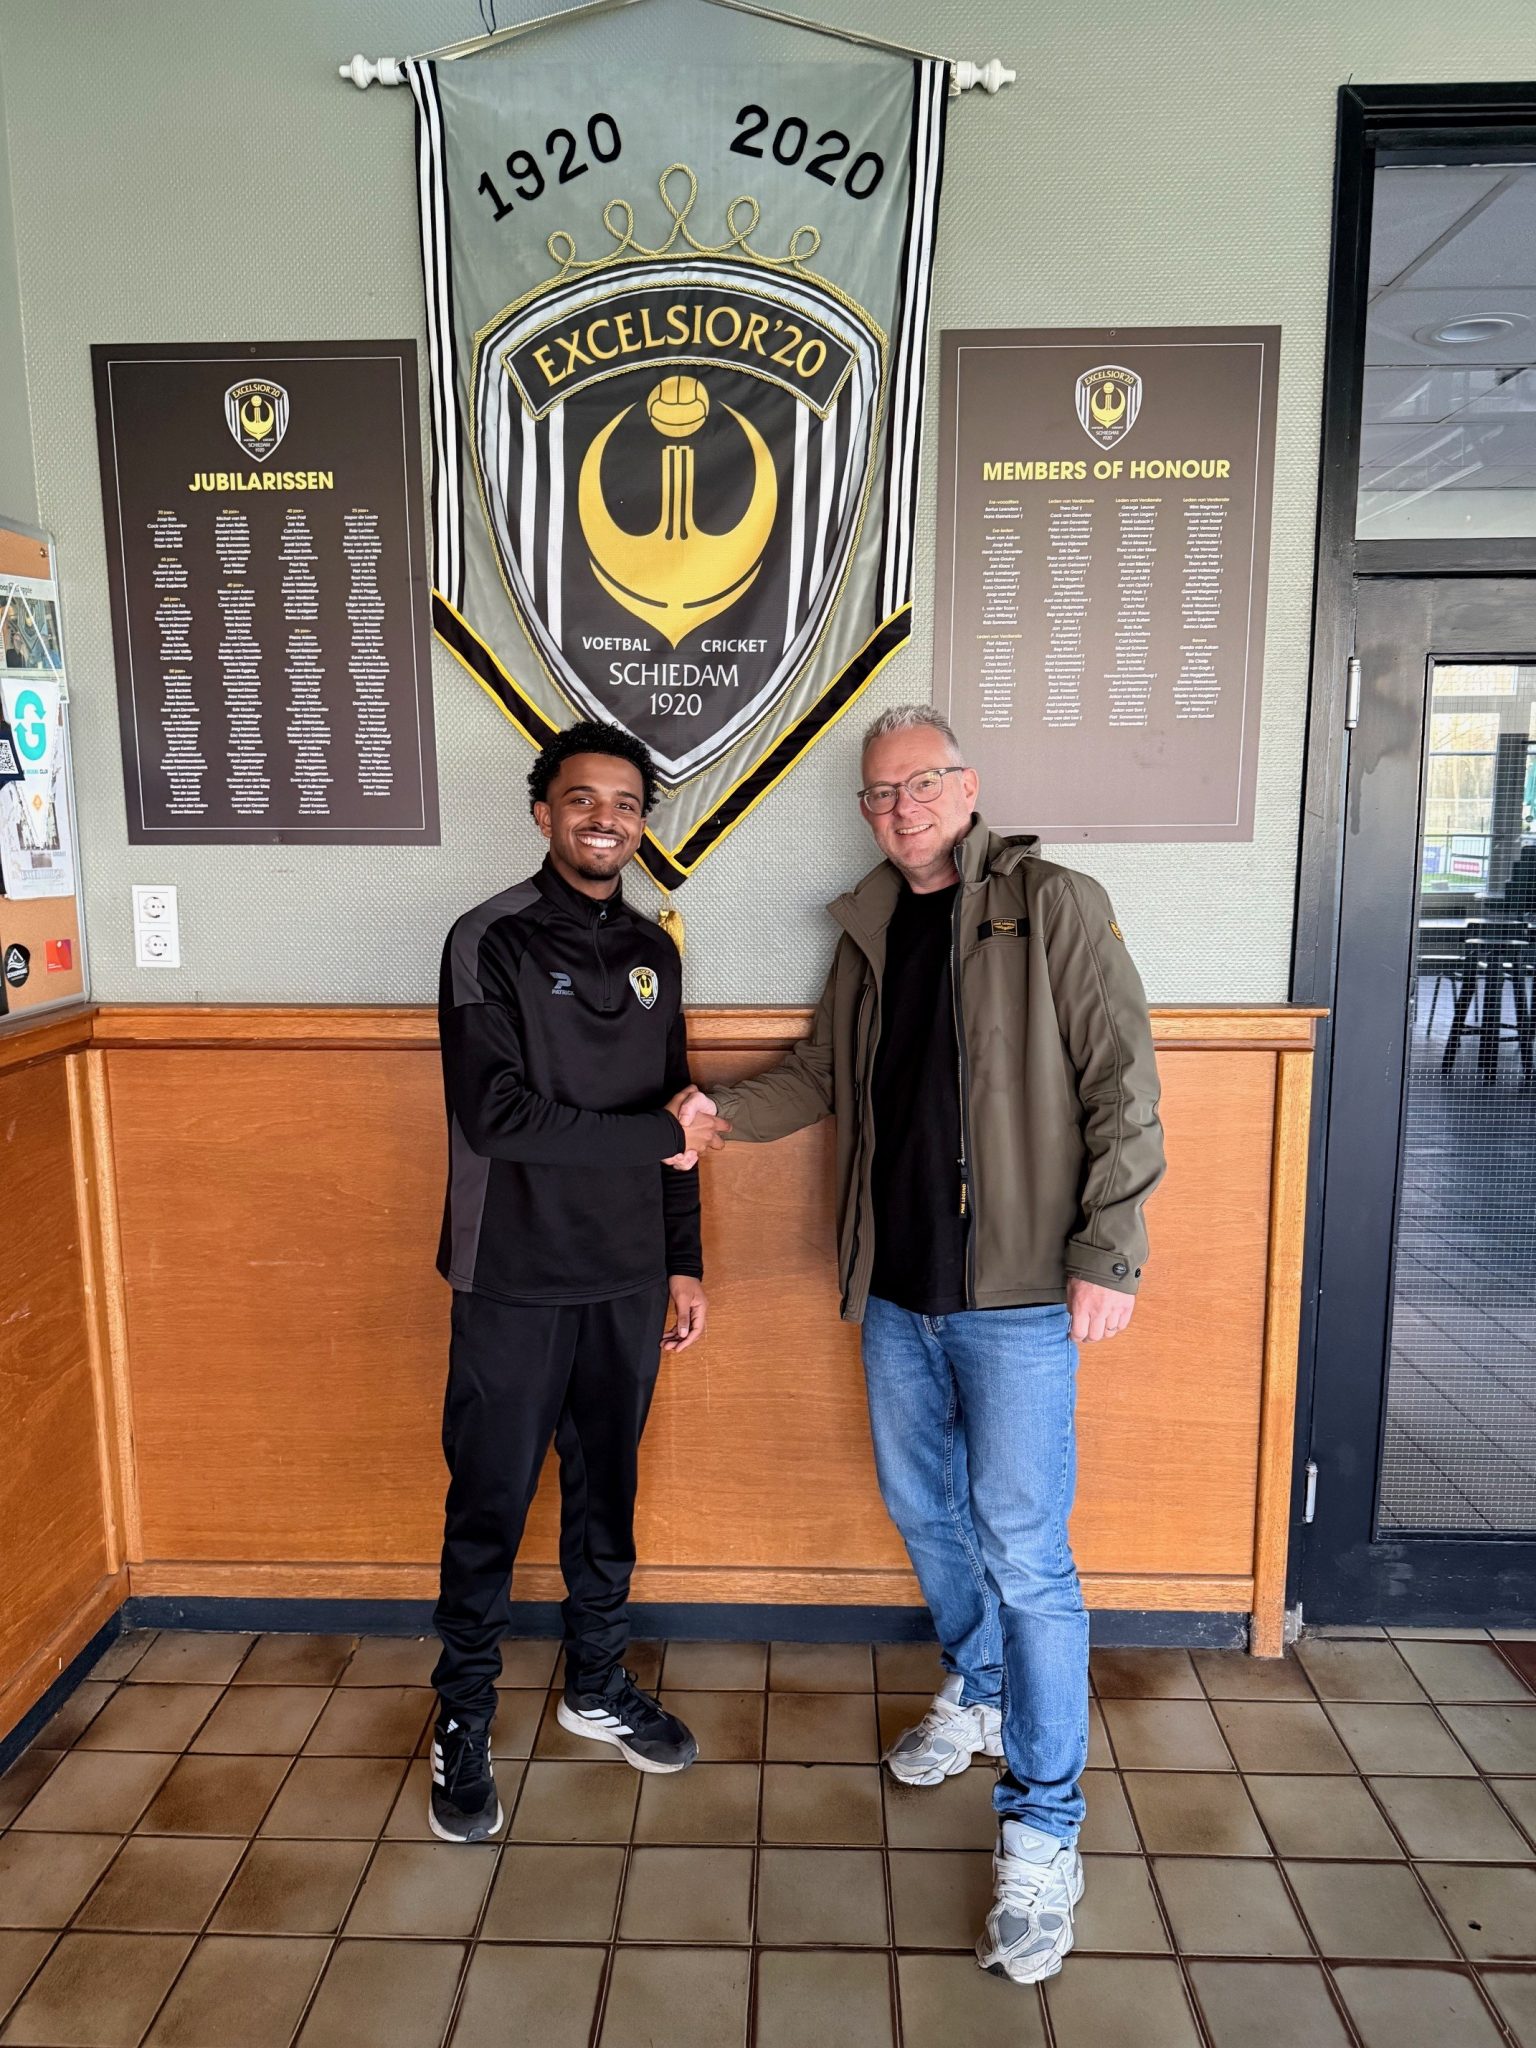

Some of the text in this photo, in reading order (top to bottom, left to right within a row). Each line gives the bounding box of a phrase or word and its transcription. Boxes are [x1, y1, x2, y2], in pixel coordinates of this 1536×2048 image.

[729, 104, 884, 200] 2020
[477, 113, 622, 222] 1920
[532, 305, 827, 387] EXCELSIOR'20
[1084, 370, 1135, 386] EXCELSIOR'20
[231, 383, 281, 399] EXCELSIOR'20
[983, 459, 1230, 481] MEMBERS OF HONOUR
[188, 471, 334, 492] JUBILARISSEN
[582, 636, 767, 653] VOETBAL CRICKET
[609, 662, 738, 687] SCHIEDAM
[650, 693, 702, 716] 1920
